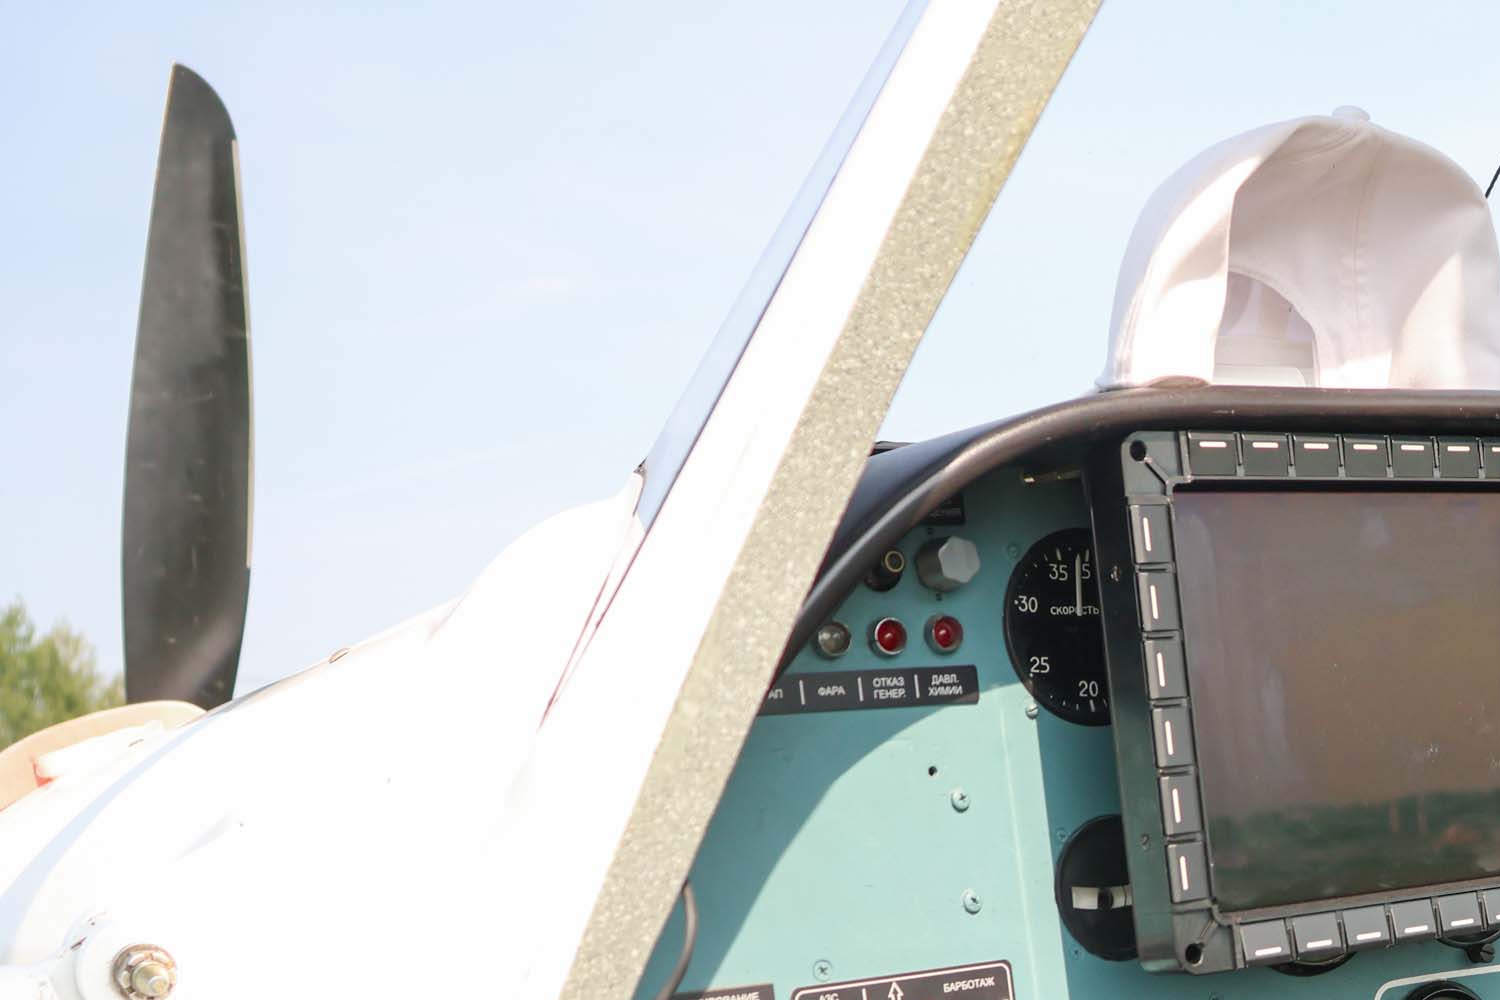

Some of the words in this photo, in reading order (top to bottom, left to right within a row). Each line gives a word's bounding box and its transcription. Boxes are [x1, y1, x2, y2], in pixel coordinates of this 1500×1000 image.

[1049, 564, 1068, 581] 35
[1081, 564, 1091, 580] 5
[1018, 595, 1038, 613] 30
[1030, 656, 1050, 673] 25
[872, 677, 904, 687] ОТКАЗ
[931, 674, 959, 685] ДАВЛ.
[767, 688, 783, 699] АП
[818, 685, 846, 696] ФАРА
[873, 688, 906, 699] ГЕНЕР.
[928, 685, 962, 696] ХИМИИ
[1078, 681, 1098, 698] 20
[943, 977, 995, 993] БАРБОТАЖ
